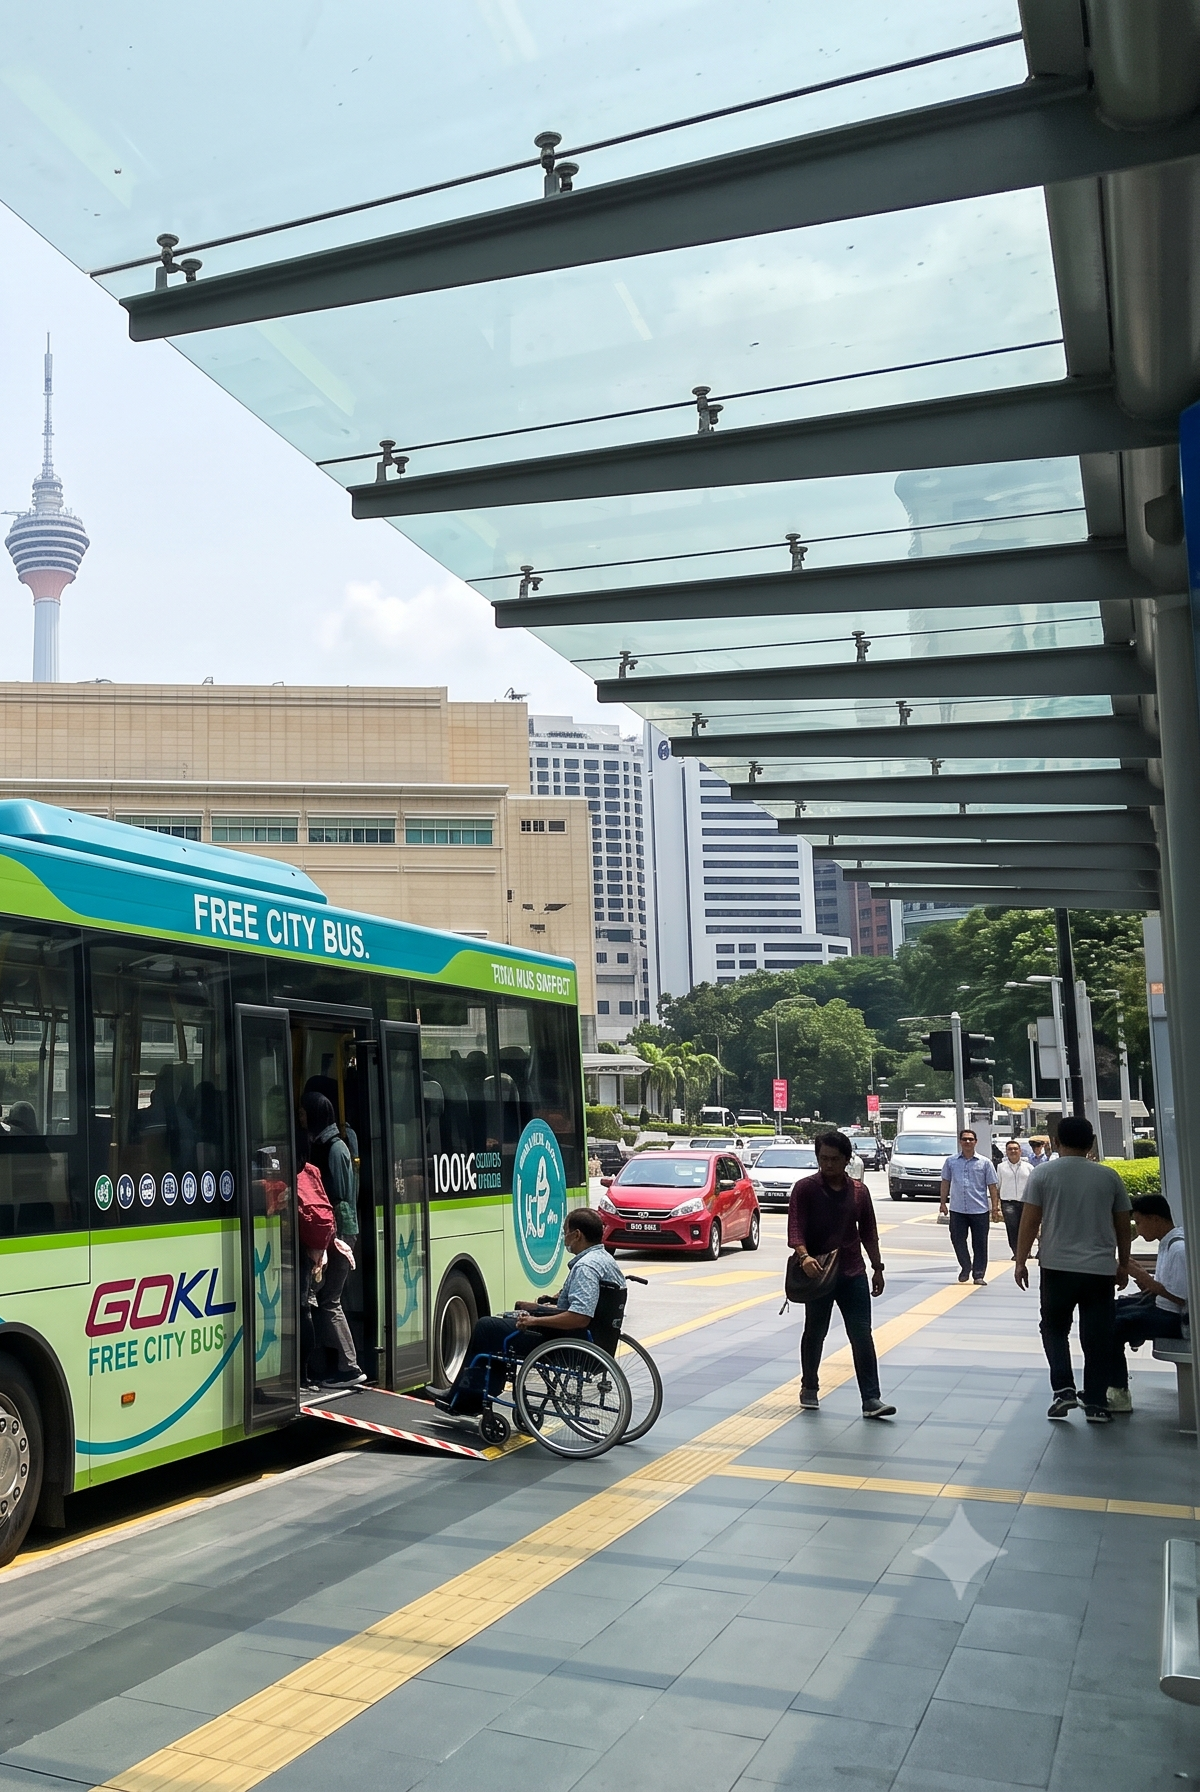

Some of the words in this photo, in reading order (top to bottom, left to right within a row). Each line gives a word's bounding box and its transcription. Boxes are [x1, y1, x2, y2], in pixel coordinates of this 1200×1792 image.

[193, 893, 260, 941] FREE
[266, 908, 317, 950] CITY
[322, 919, 371, 960] BUS.
[85, 1267, 237, 1338] GOKL
[88, 1339, 139, 1377] FREE
[144, 1330, 186, 1364] CITY
